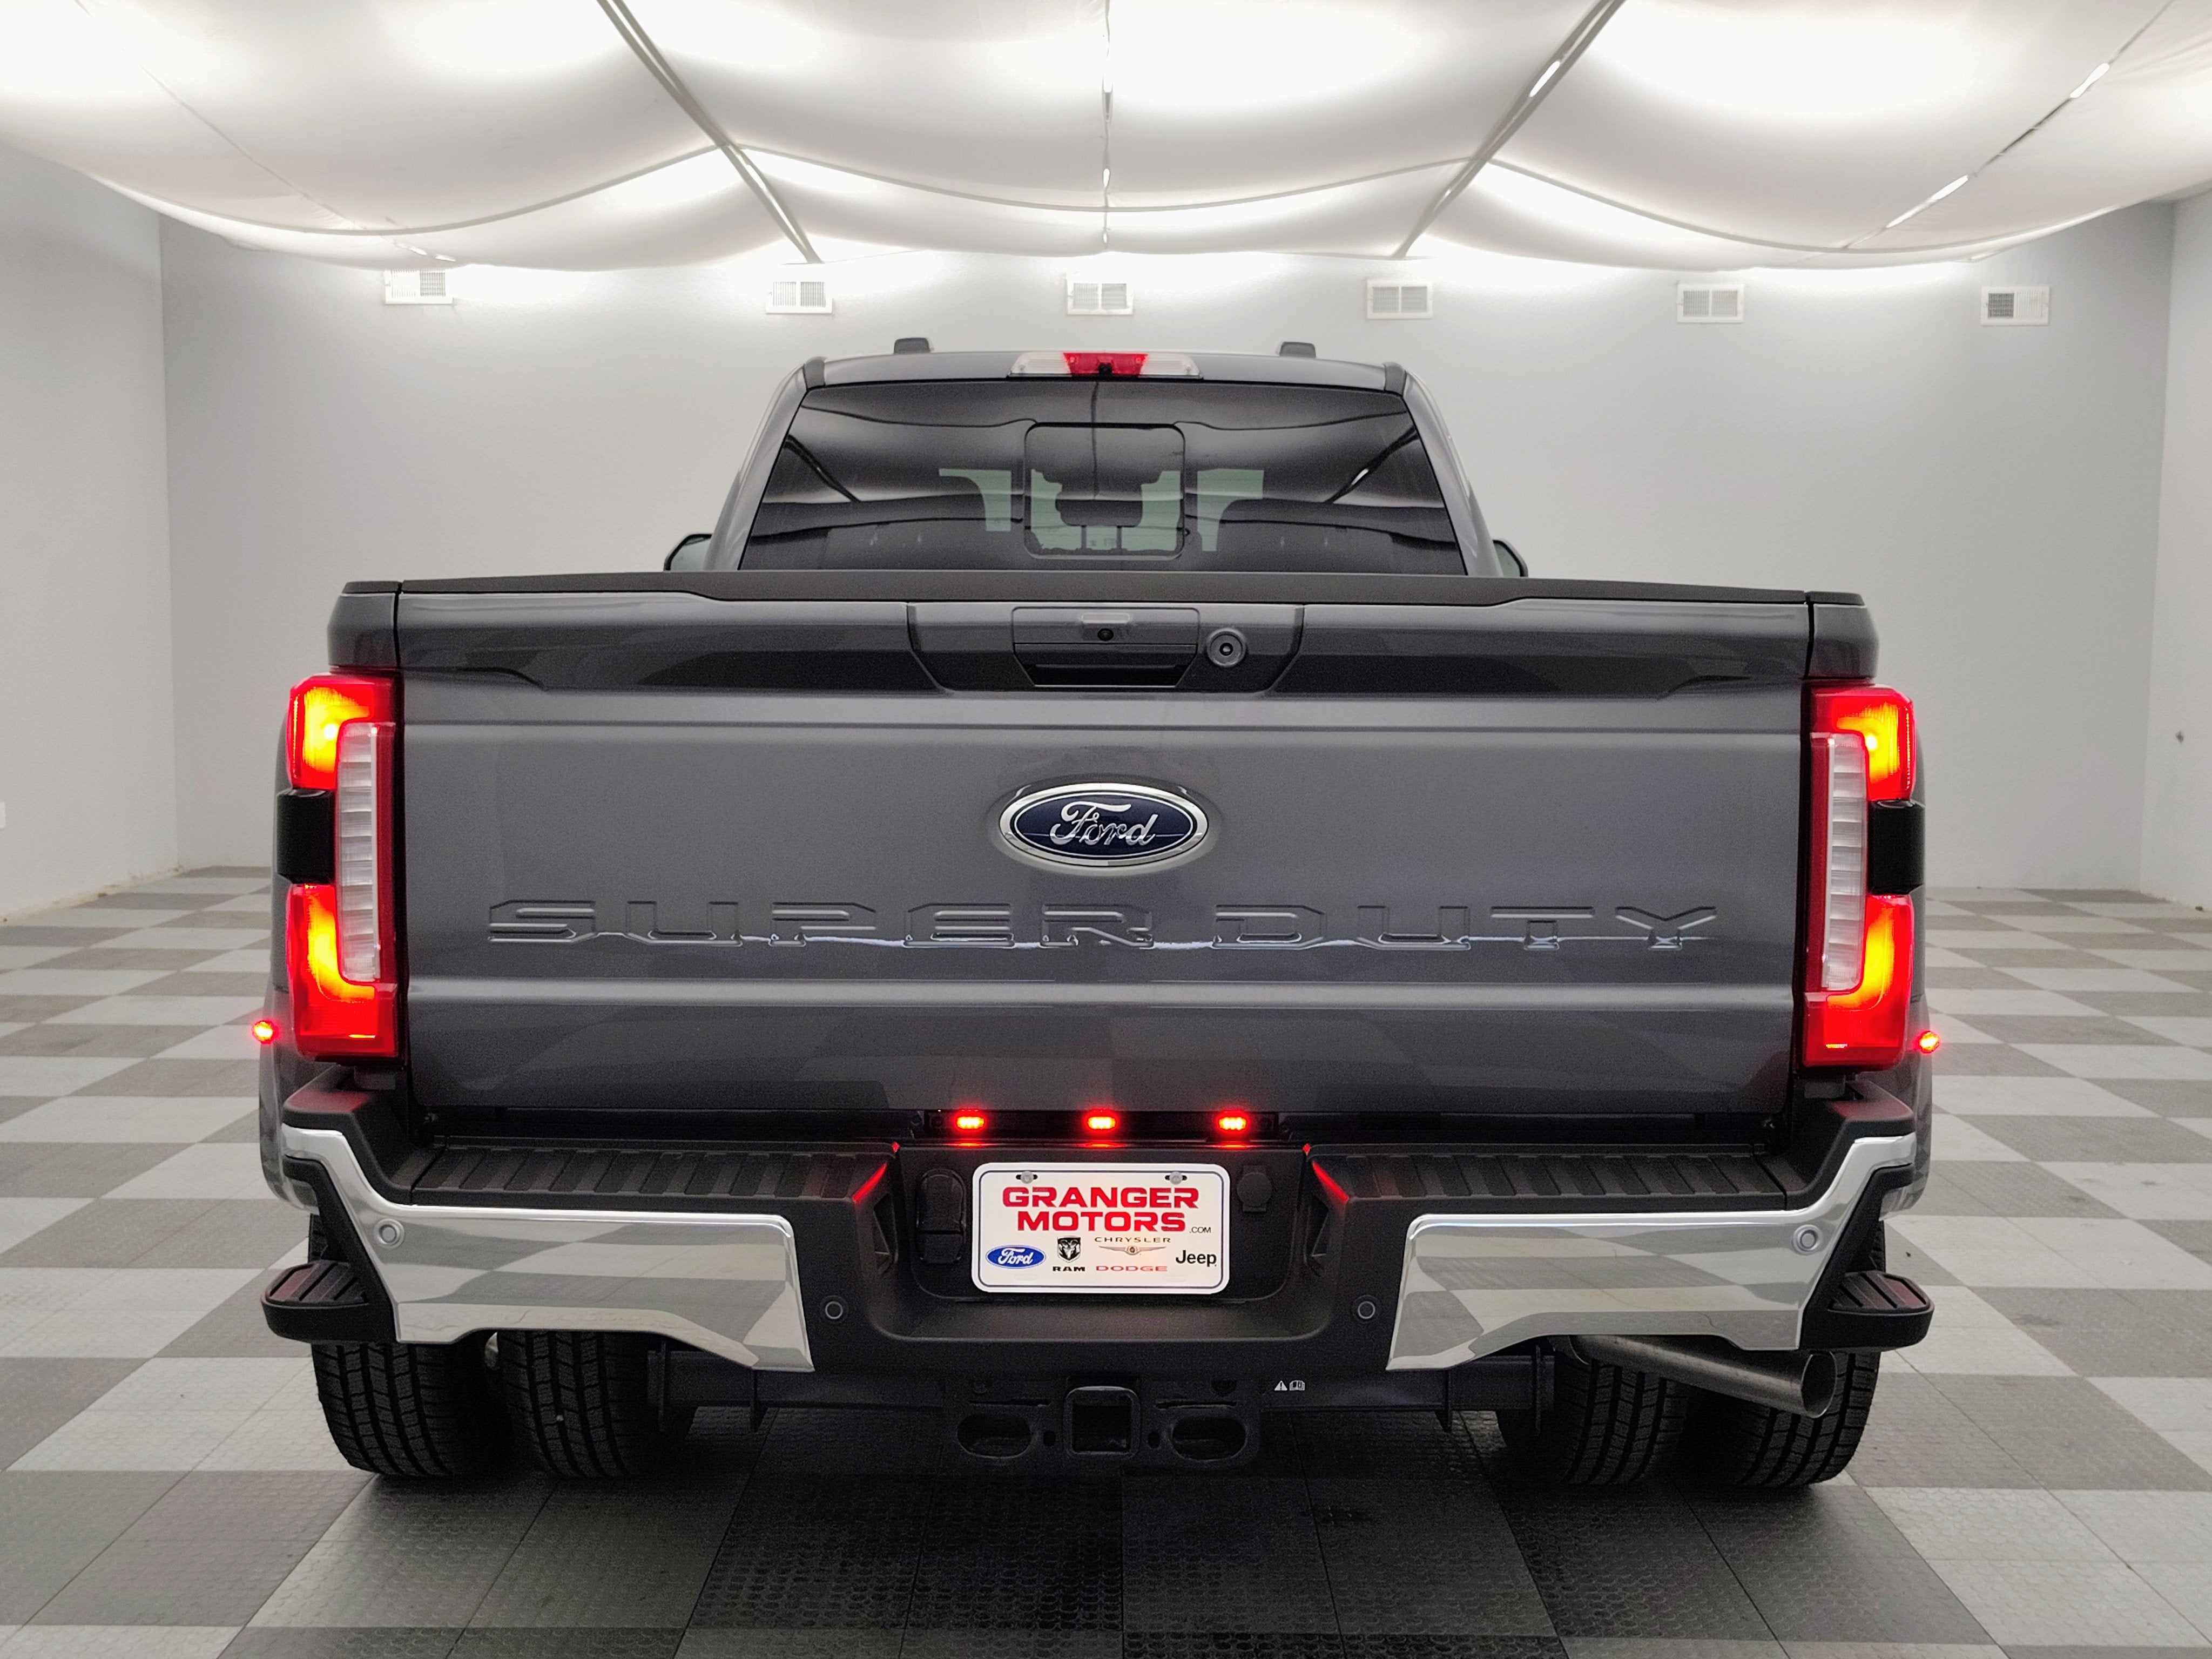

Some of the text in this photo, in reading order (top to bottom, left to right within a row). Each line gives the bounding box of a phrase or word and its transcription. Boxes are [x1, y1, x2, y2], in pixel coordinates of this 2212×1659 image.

[1050, 800, 1158, 846] Ford
[487, 899, 1718, 951] SUPER DUTY
[1002, 1186, 1199, 1209] GRANGER
[1017, 1211, 1186, 1232] MOTORS
[997, 1247, 1034, 1265] Ford
[1175, 1250, 1217, 1267] Jeep
